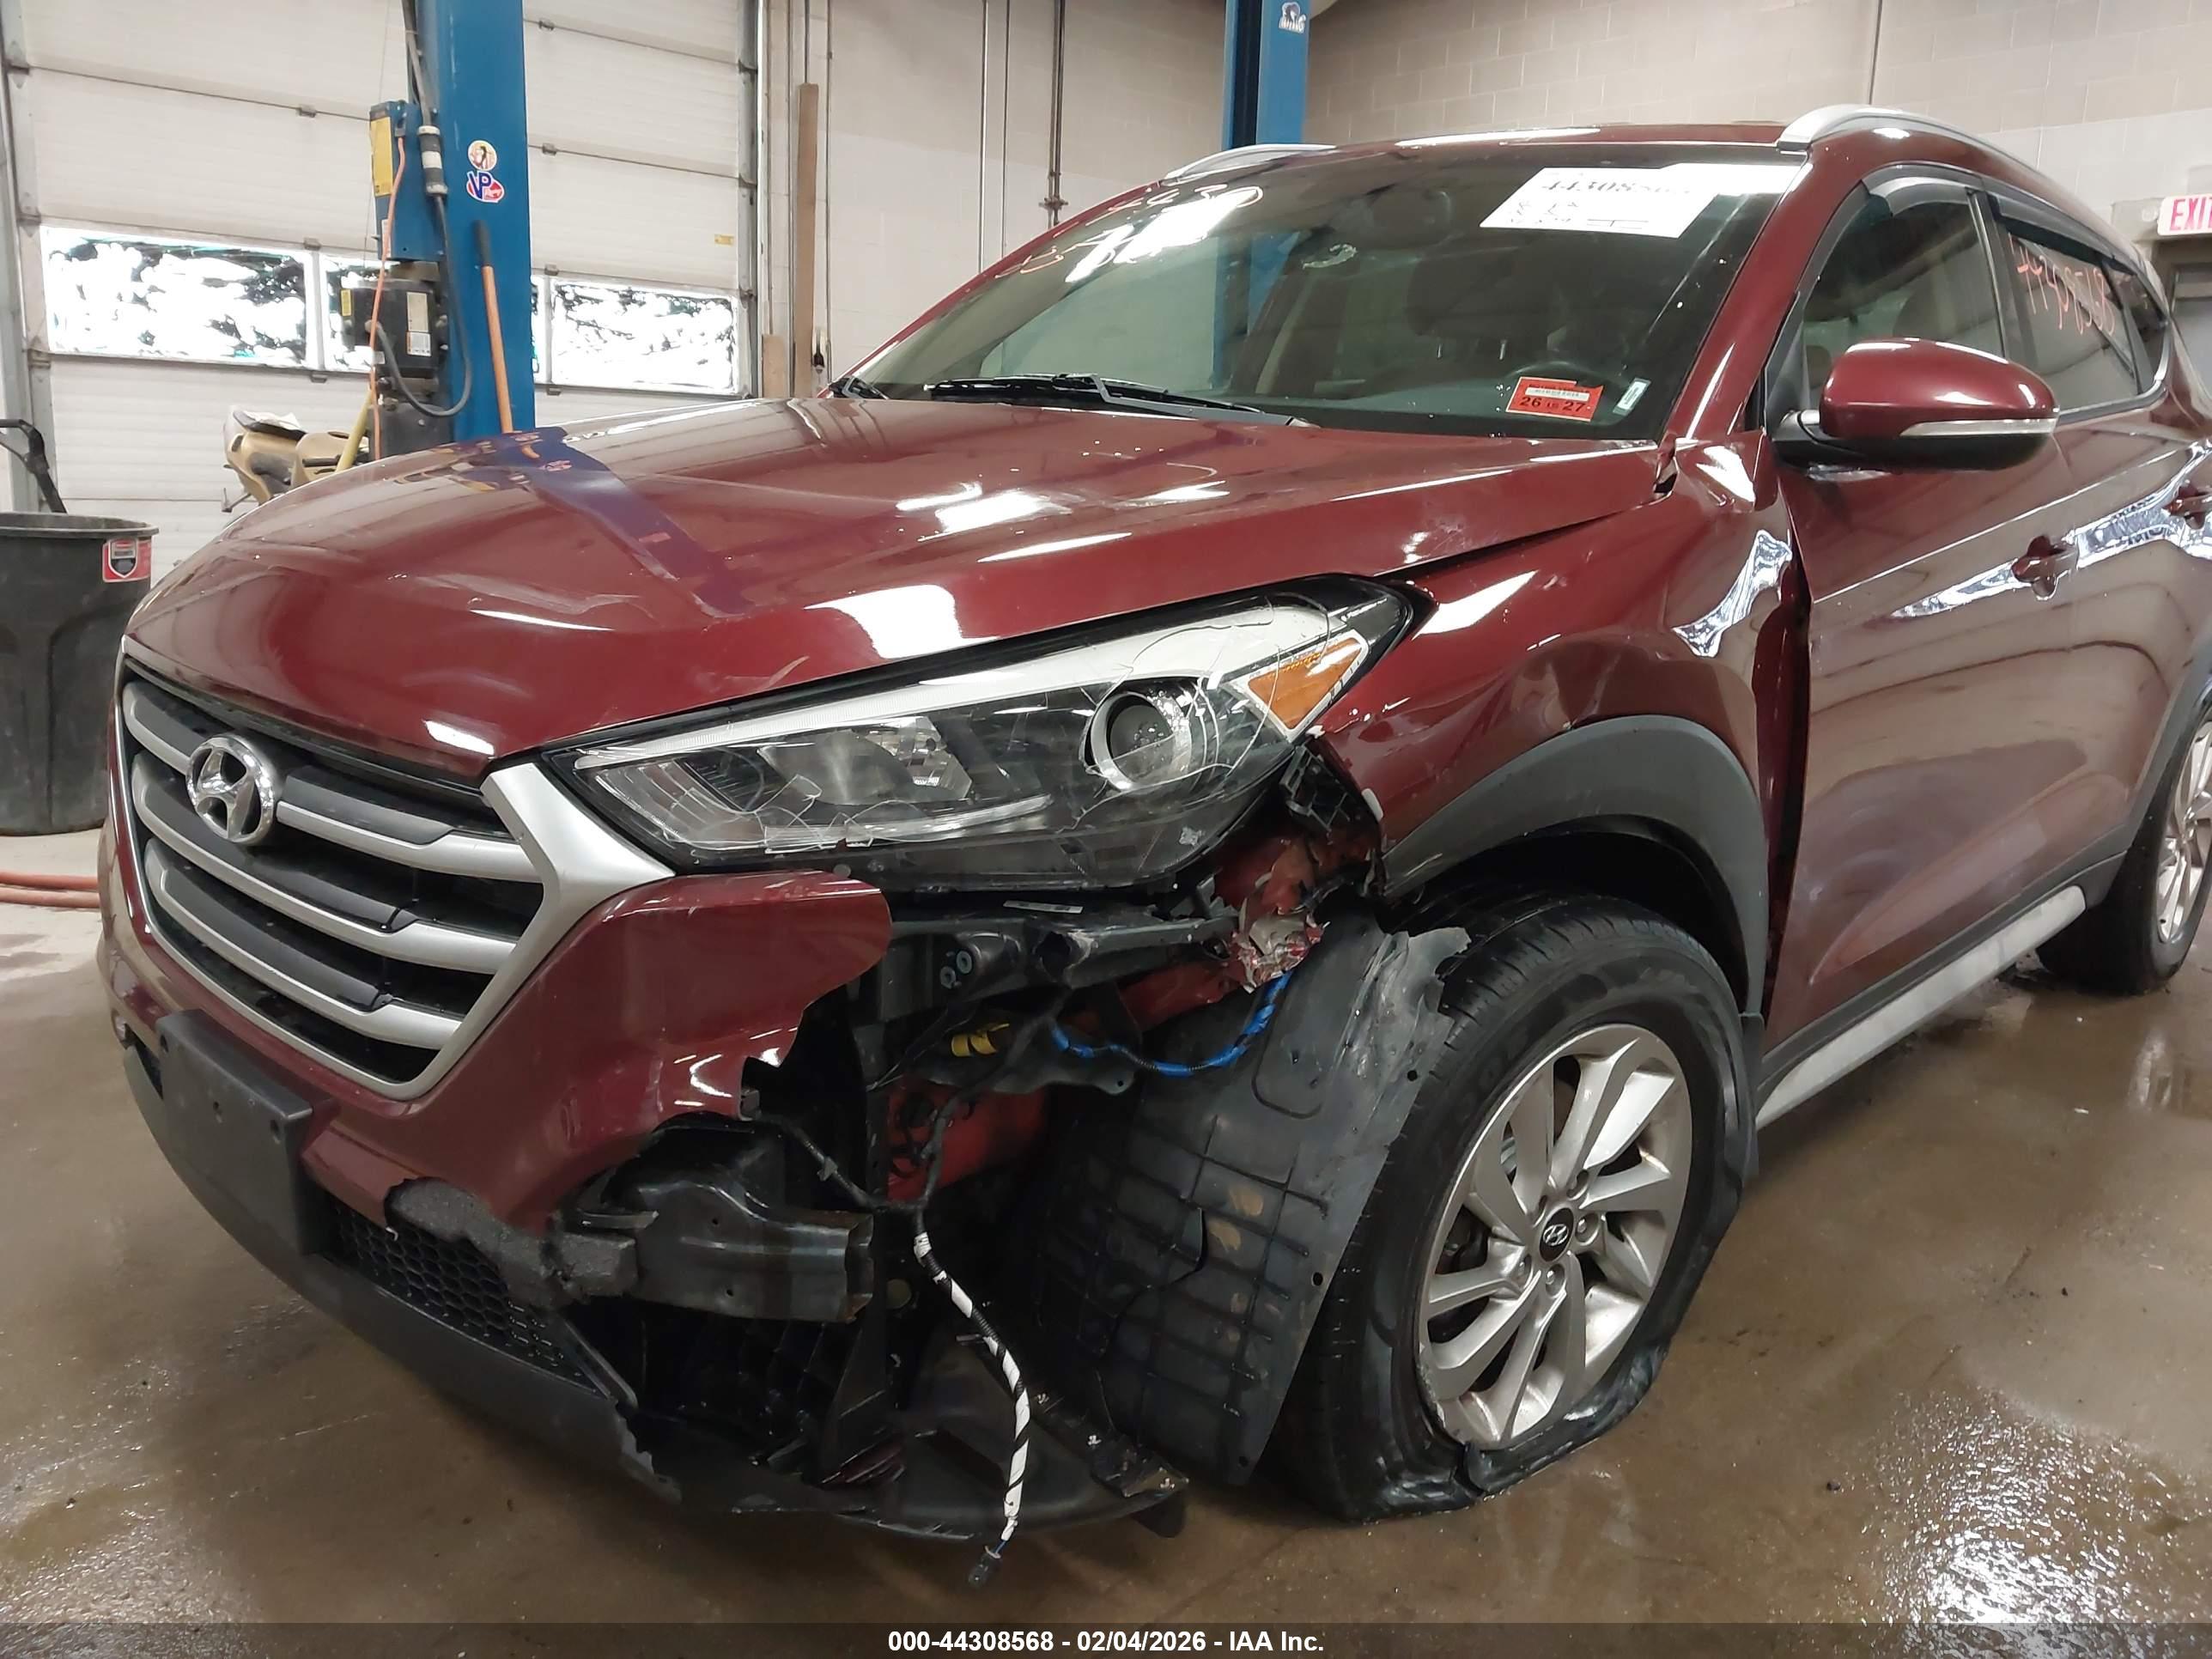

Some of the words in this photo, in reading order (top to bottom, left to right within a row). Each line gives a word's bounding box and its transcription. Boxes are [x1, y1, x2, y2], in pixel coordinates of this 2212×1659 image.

[468, 171, 492, 200] VP
[1519, 396, 1542, 408] 26
[1562, 400, 1586, 412] 27
